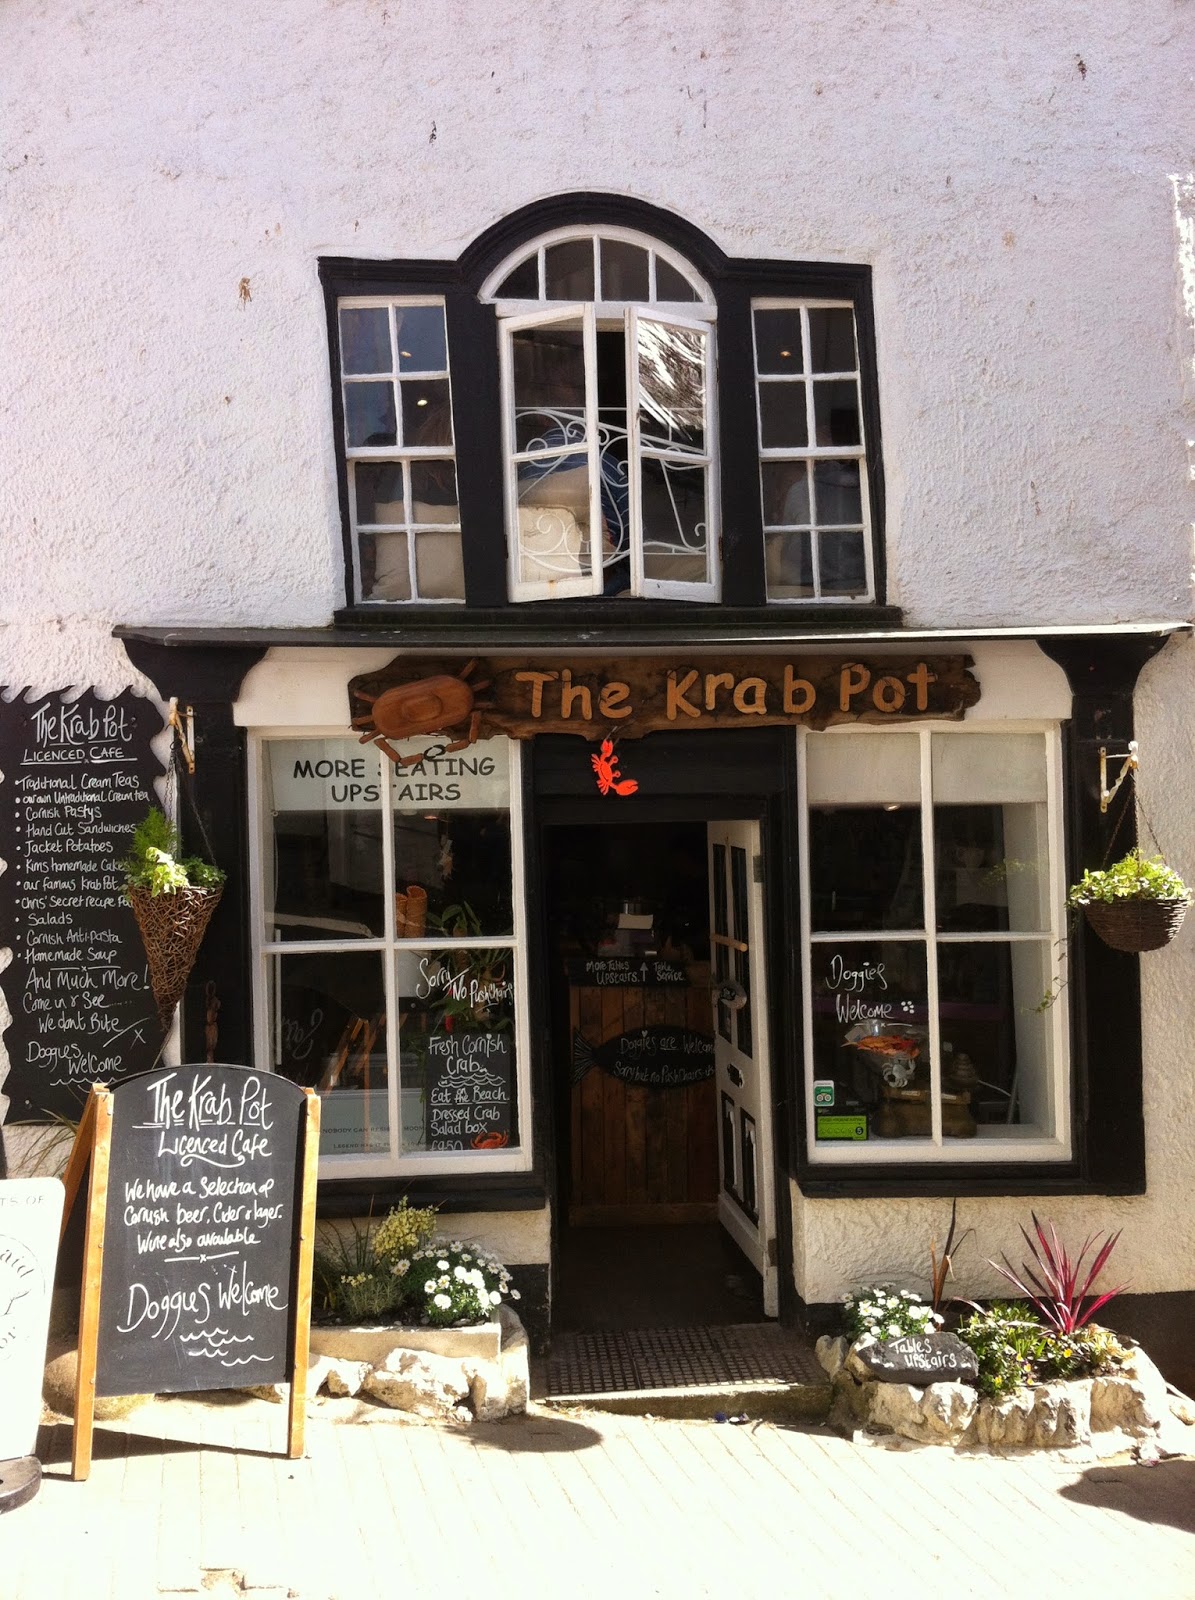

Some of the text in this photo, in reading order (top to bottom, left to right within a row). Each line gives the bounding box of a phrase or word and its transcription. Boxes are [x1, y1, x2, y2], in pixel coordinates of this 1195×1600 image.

[514, 662, 938, 721] The Krab Pot
[31, 702, 132, 747] The Krab Pot
[23, 747, 125, 763] LICENCED CAFE
[293, 759, 366, 779] MORE
[21, 770, 140, 791] Traditional Cream Teas
[25, 804, 102, 825] Cornish Pastys
[25, 822, 138, 838] Hand Cut Sandwiches
[24, 838, 114, 857] Jacket Potatoes
[26, 858, 49, 874] Kims
[23, 880, 40, 891] our
[43, 876, 76, 891] famous
[103, 875, 119, 891] Pot
[49, 895, 83, 908] Secret
[85, 895, 116, 909] recipe
[28, 911, 73, 926] Salads
[26, 931, 64, 946] Cornish
[25, 948, 117, 964] Homemade Soup
[586, 961, 606, 973] More
[826, 954, 888, 993] Doggies
[25, 967, 51, 990] And
[57, 970, 98, 990] Much
[452, 974, 467, 1001] No
[22, 992, 52, 1014] Come
[54, 996, 66, 1008] in
[836, 993, 896, 1024] Welcome
[38, 1014, 56, 1034] We
[87, 1012, 124, 1034] Bite
[428, 1034, 507, 1058] Fresh Cornish
[660, 1037, 677, 1050] are
[26, 1041, 82, 1074] Doggies
[68, 1052, 126, 1075] Welcome
[446, 1055, 481, 1075] Crab
[147, 1073, 274, 1132] The Krab Pot
[431, 1088, 452, 1103] Eat
[431, 1105, 500, 1123] Dressed Crab
[430, 1121, 488, 1137] Salad box
[158, 1129, 272, 1160] Licenced Cafe
[125, 1178, 143, 1202] We
[145, 1179, 181, 1202] have
[182, 1180, 196, 1195] a
[258, 1178, 274, 1199] of
[124, 1205, 169, 1227] Cornish
[212, 1201, 241, 1223] Cider
[137, 1228, 261, 1255] Wine also available
[116, 1260, 288, 1341] Doggies Welcome
[888, 1338, 932, 1354] Tables
